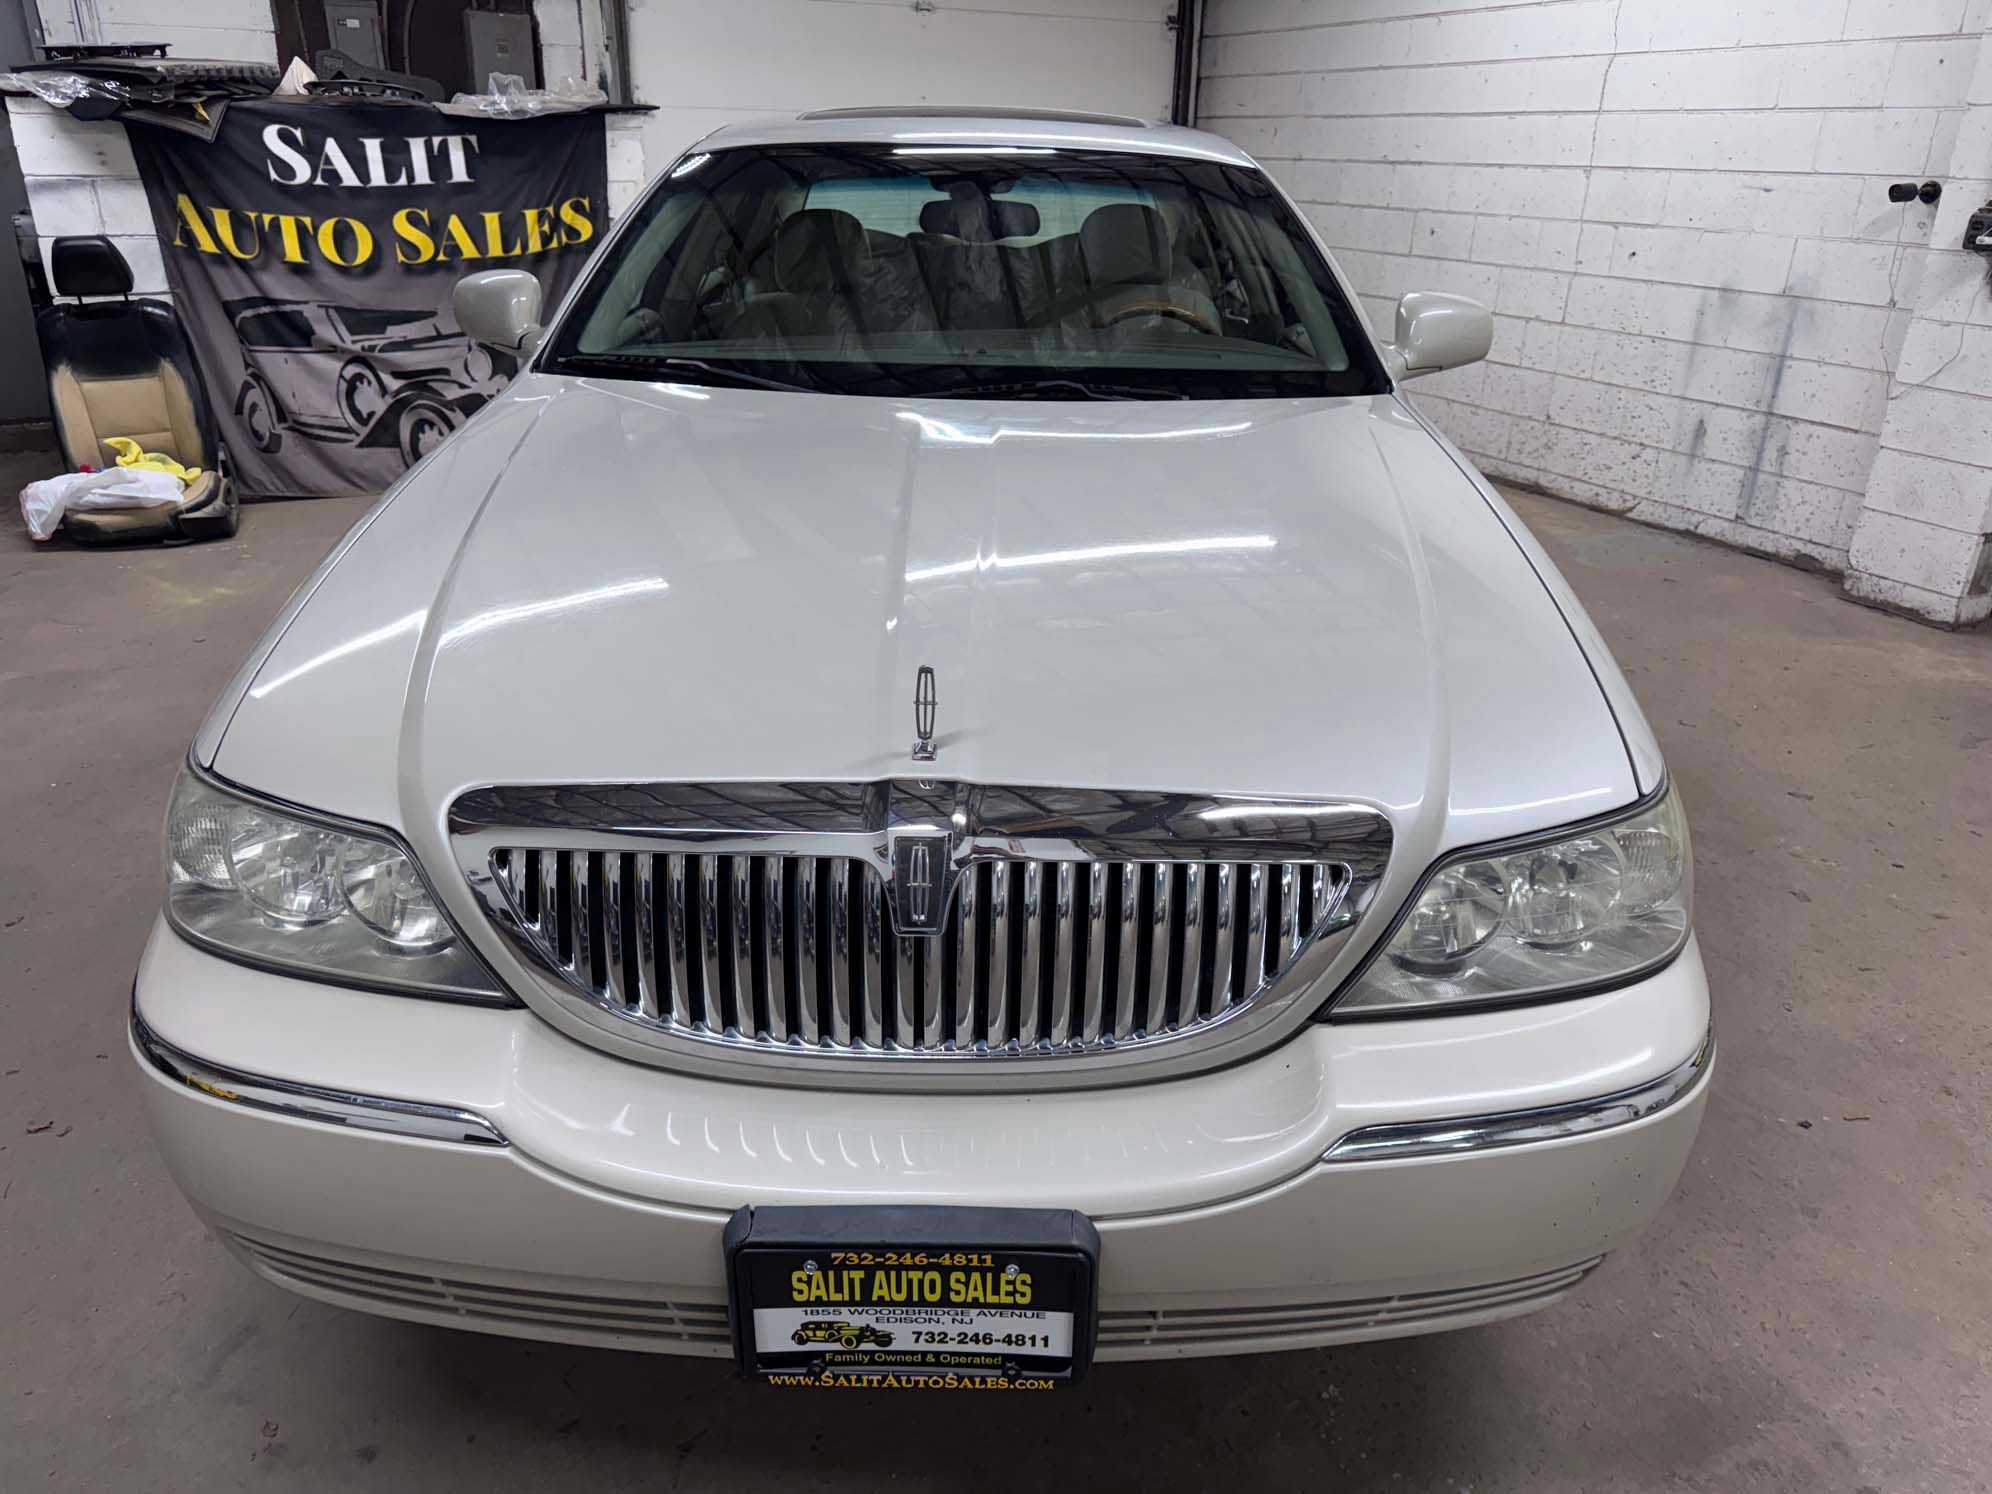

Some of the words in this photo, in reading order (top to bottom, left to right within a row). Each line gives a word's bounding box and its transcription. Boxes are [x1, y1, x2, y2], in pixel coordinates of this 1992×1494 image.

[262, 123, 480, 188] SALIT
[172, 193, 374, 268] AUTO
[392, 196, 594, 264] SALES
[831, 1252, 995, 1267] 732-246-4811
[791, 1270, 865, 1302] SALIT
[871, 1270, 942, 1302] AUTO
[949, 1271, 1032, 1304] SALES
[802, 1308, 842, 1316] 1855
[847, 1308, 971, 1317] WOODBRIDGE
[976, 1310, 1047, 1319] AVENUE
[875, 1317, 945, 1325] EDISON,
[911, 1331, 1050, 1348] 732-246-4811
[825, 1352, 870, 1363] Family
[874, 1353, 921, 1363] Owned
[925, 1353, 936, 1363] &
[940, 1354, 1002, 1365] Operated
